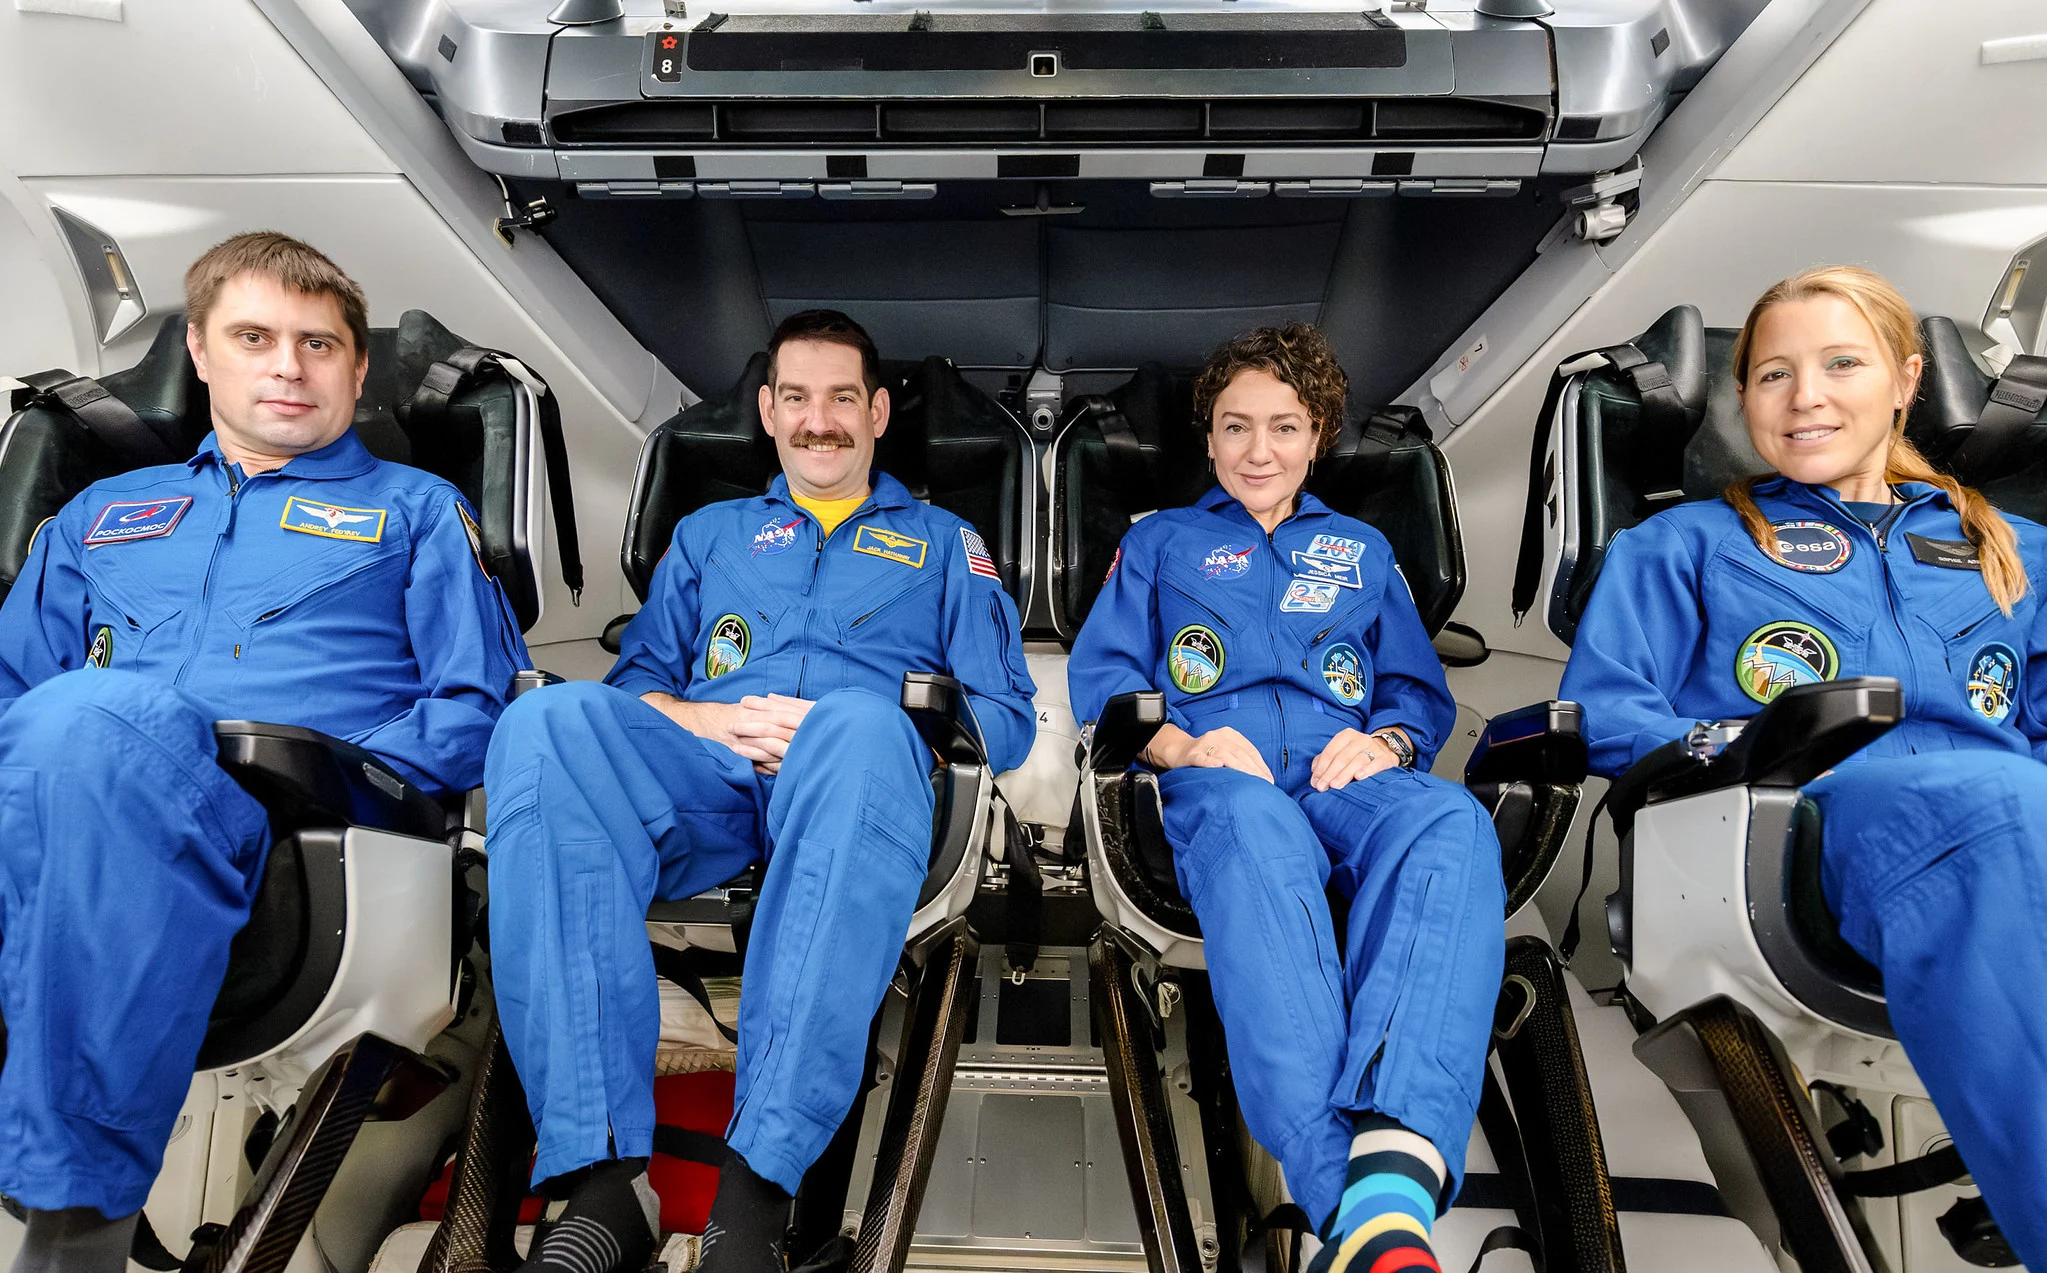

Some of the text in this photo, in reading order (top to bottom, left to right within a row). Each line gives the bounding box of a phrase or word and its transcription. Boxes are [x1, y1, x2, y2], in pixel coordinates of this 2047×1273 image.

[661, 58, 673, 74] 8
[95, 522, 167, 537] РОСКОСМОС
[299, 522, 329, 533] ANDREY
[753, 527, 796, 543] NASA
[1205, 555, 1250, 567] NASA
